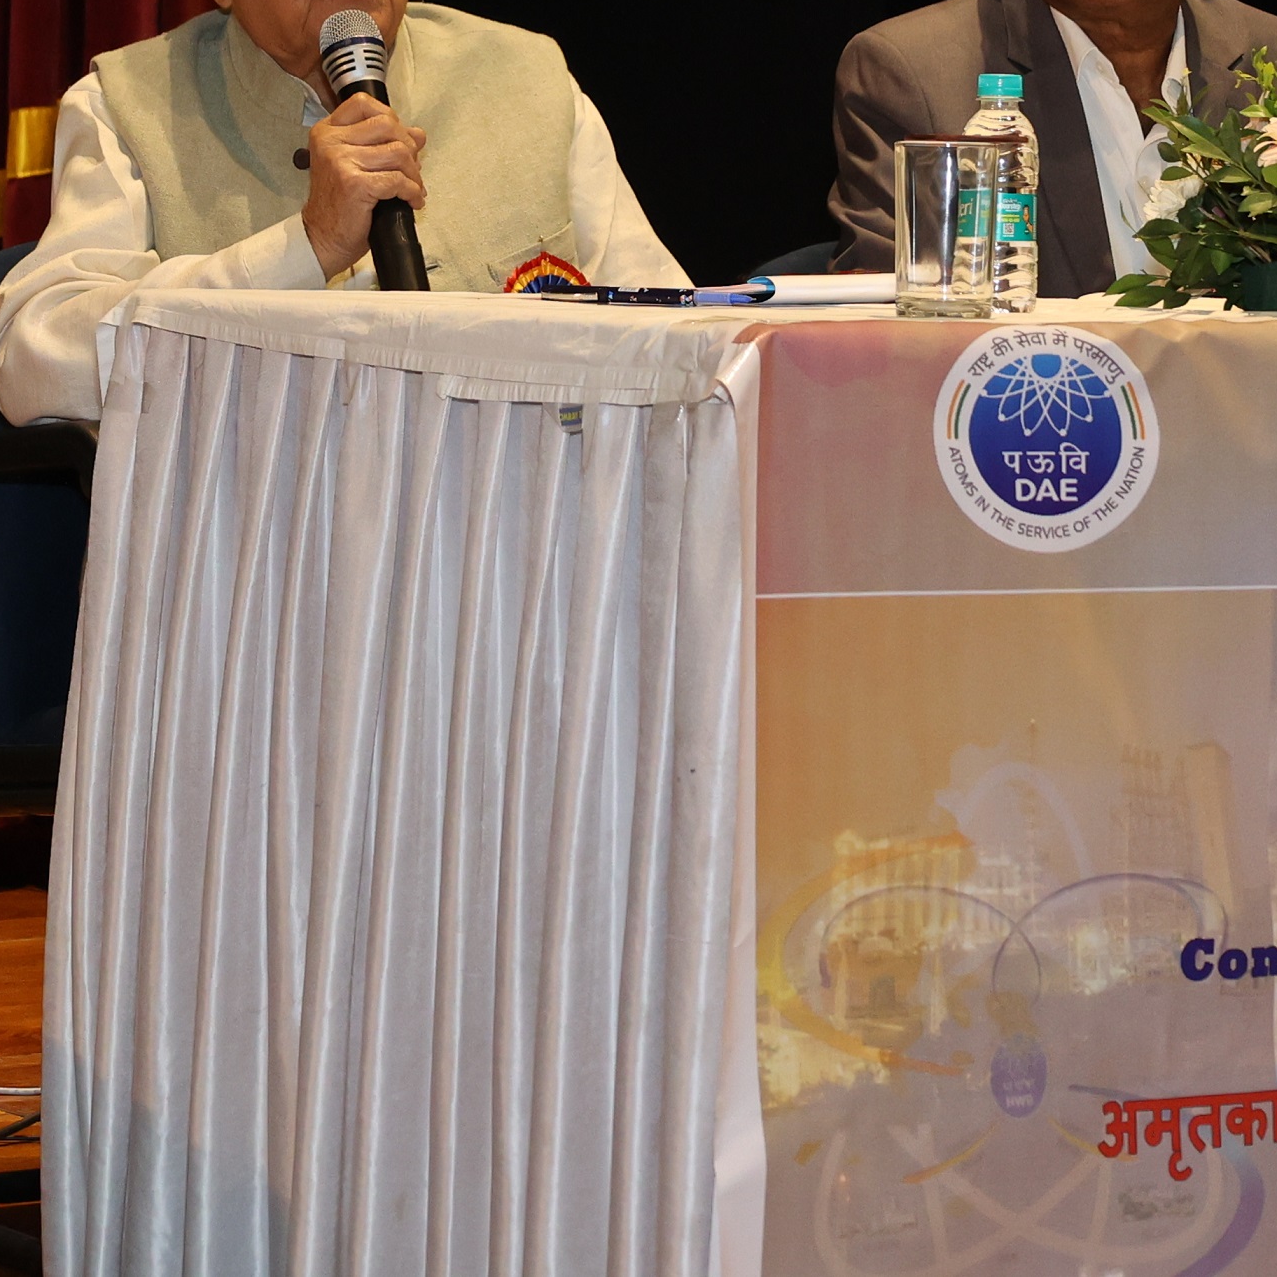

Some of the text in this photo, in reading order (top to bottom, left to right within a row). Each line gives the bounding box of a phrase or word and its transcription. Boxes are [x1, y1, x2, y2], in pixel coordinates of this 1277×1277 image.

[968, 329, 1125, 384] राष्ट्र की सेवा में परमाणु
[949, 446, 1145, 539] ATOMS IN THE SERVICE OF THE NATION
[1015, 479, 1078, 502] DAE
